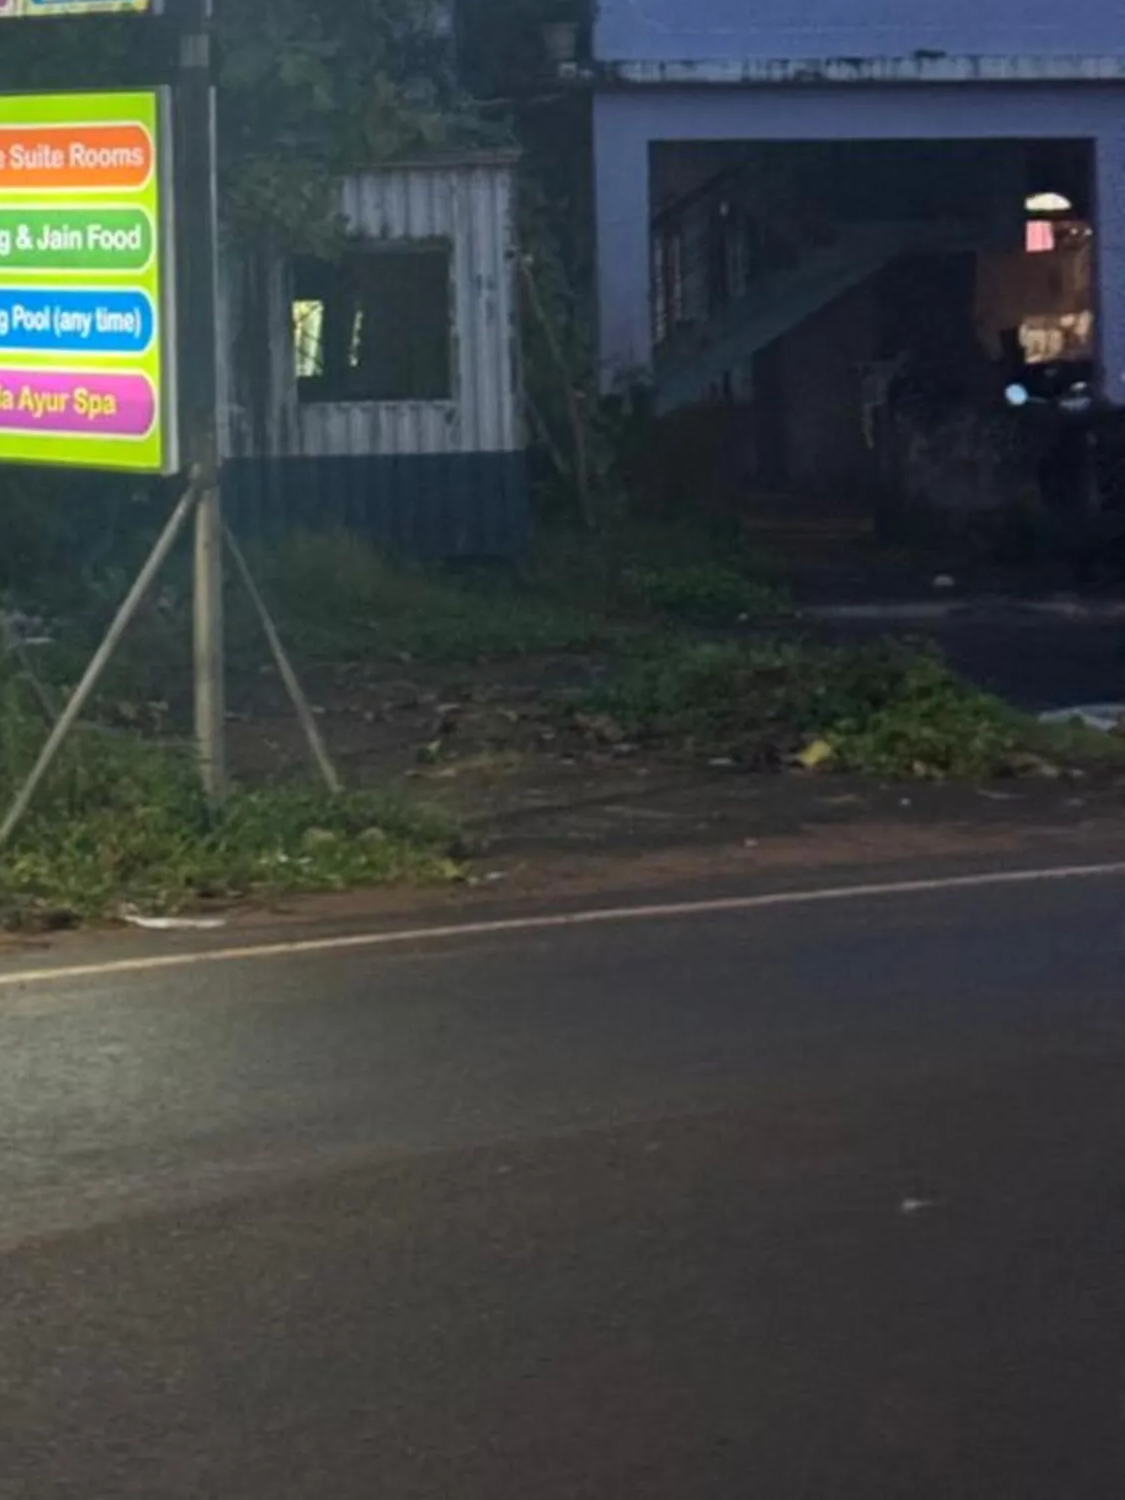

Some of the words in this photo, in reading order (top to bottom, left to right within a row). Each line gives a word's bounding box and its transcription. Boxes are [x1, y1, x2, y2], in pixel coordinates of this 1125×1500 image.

[10, 144, 63, 169] Suite
[69, 142, 144, 168] Rooms
[16, 224, 32, 249] &
[37, 223, 83, 250] Jain
[87, 223, 142, 250] Food
[12, 304, 50, 330] Pool
[53, 306, 92, 338] (any
[96, 307, 142, 336] time)
[18, 385, 68, 418] Ayur
[73, 387, 117, 419] Spa
